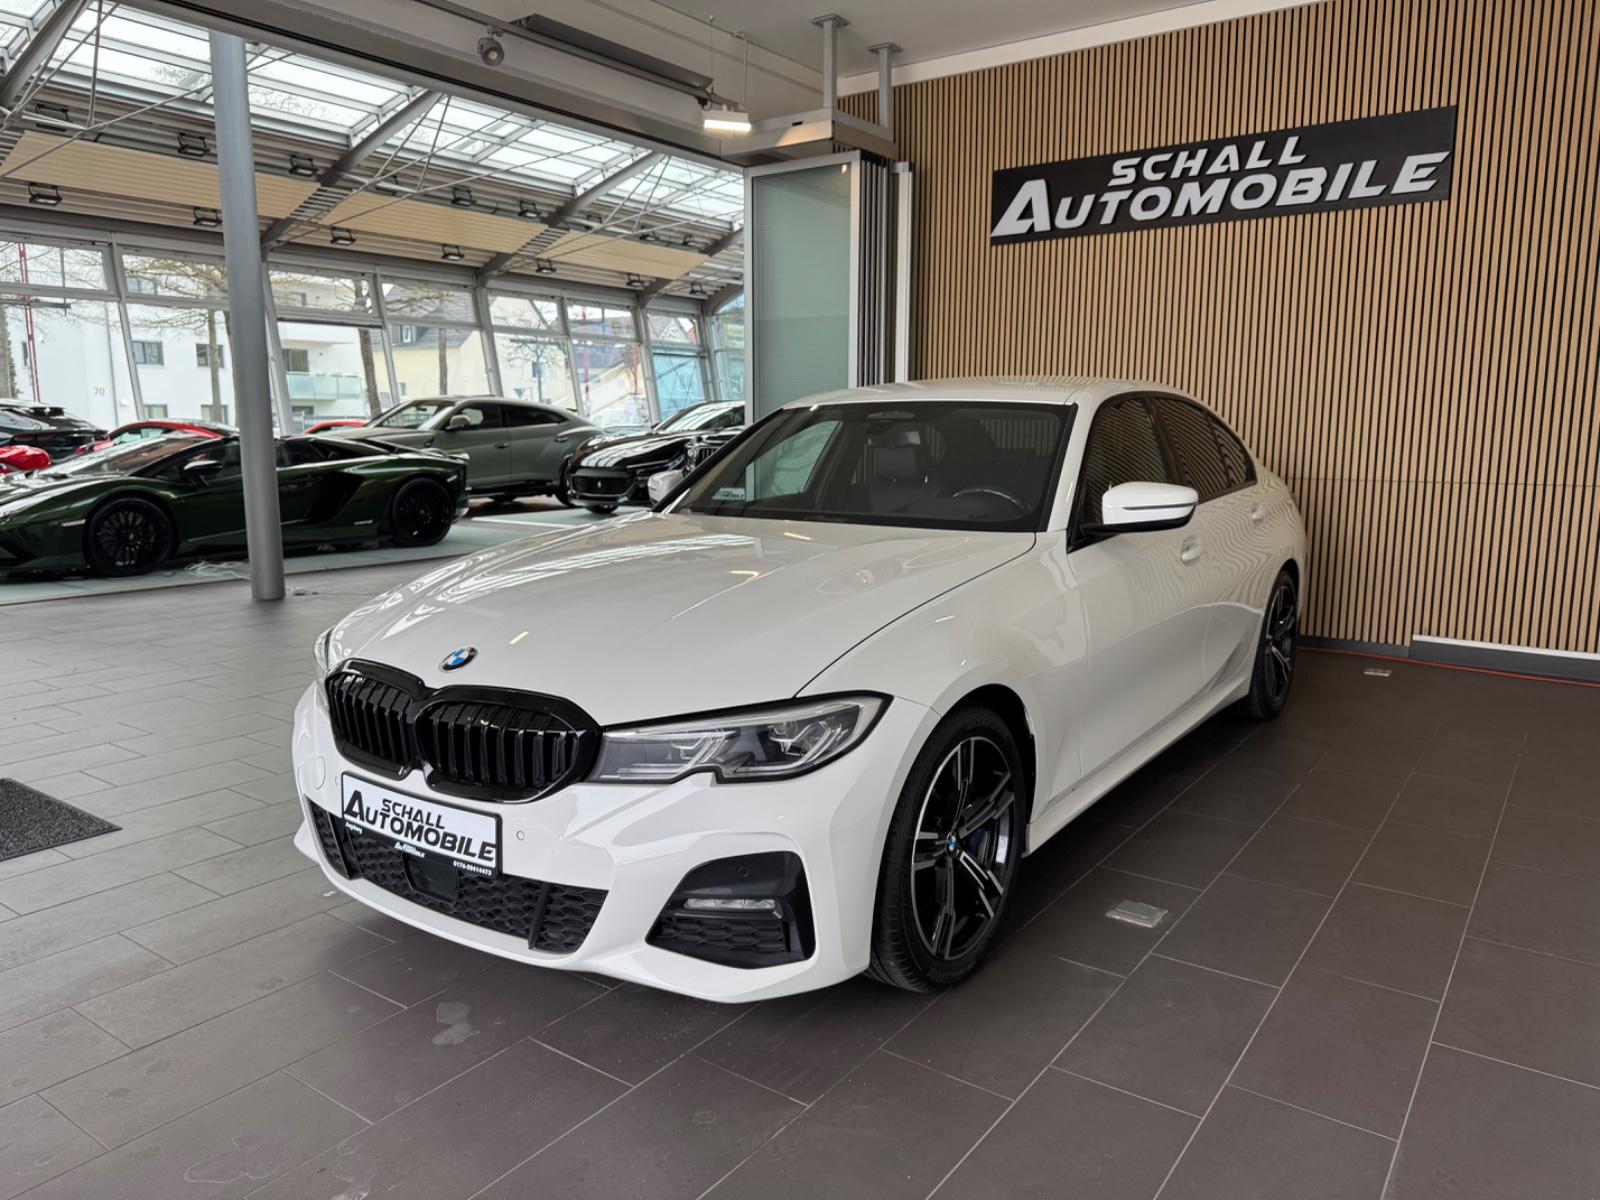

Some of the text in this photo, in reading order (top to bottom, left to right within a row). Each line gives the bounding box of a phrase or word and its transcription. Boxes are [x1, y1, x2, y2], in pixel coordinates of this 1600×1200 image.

[1107, 135, 1307, 187] SCHALL
[991, 150, 1450, 238] AUTOMOBILE
[92, 386, 105, 396] 70
[344, 789, 496, 862] AUTOMOBILE
[381, 798, 446, 830] SCHALL
